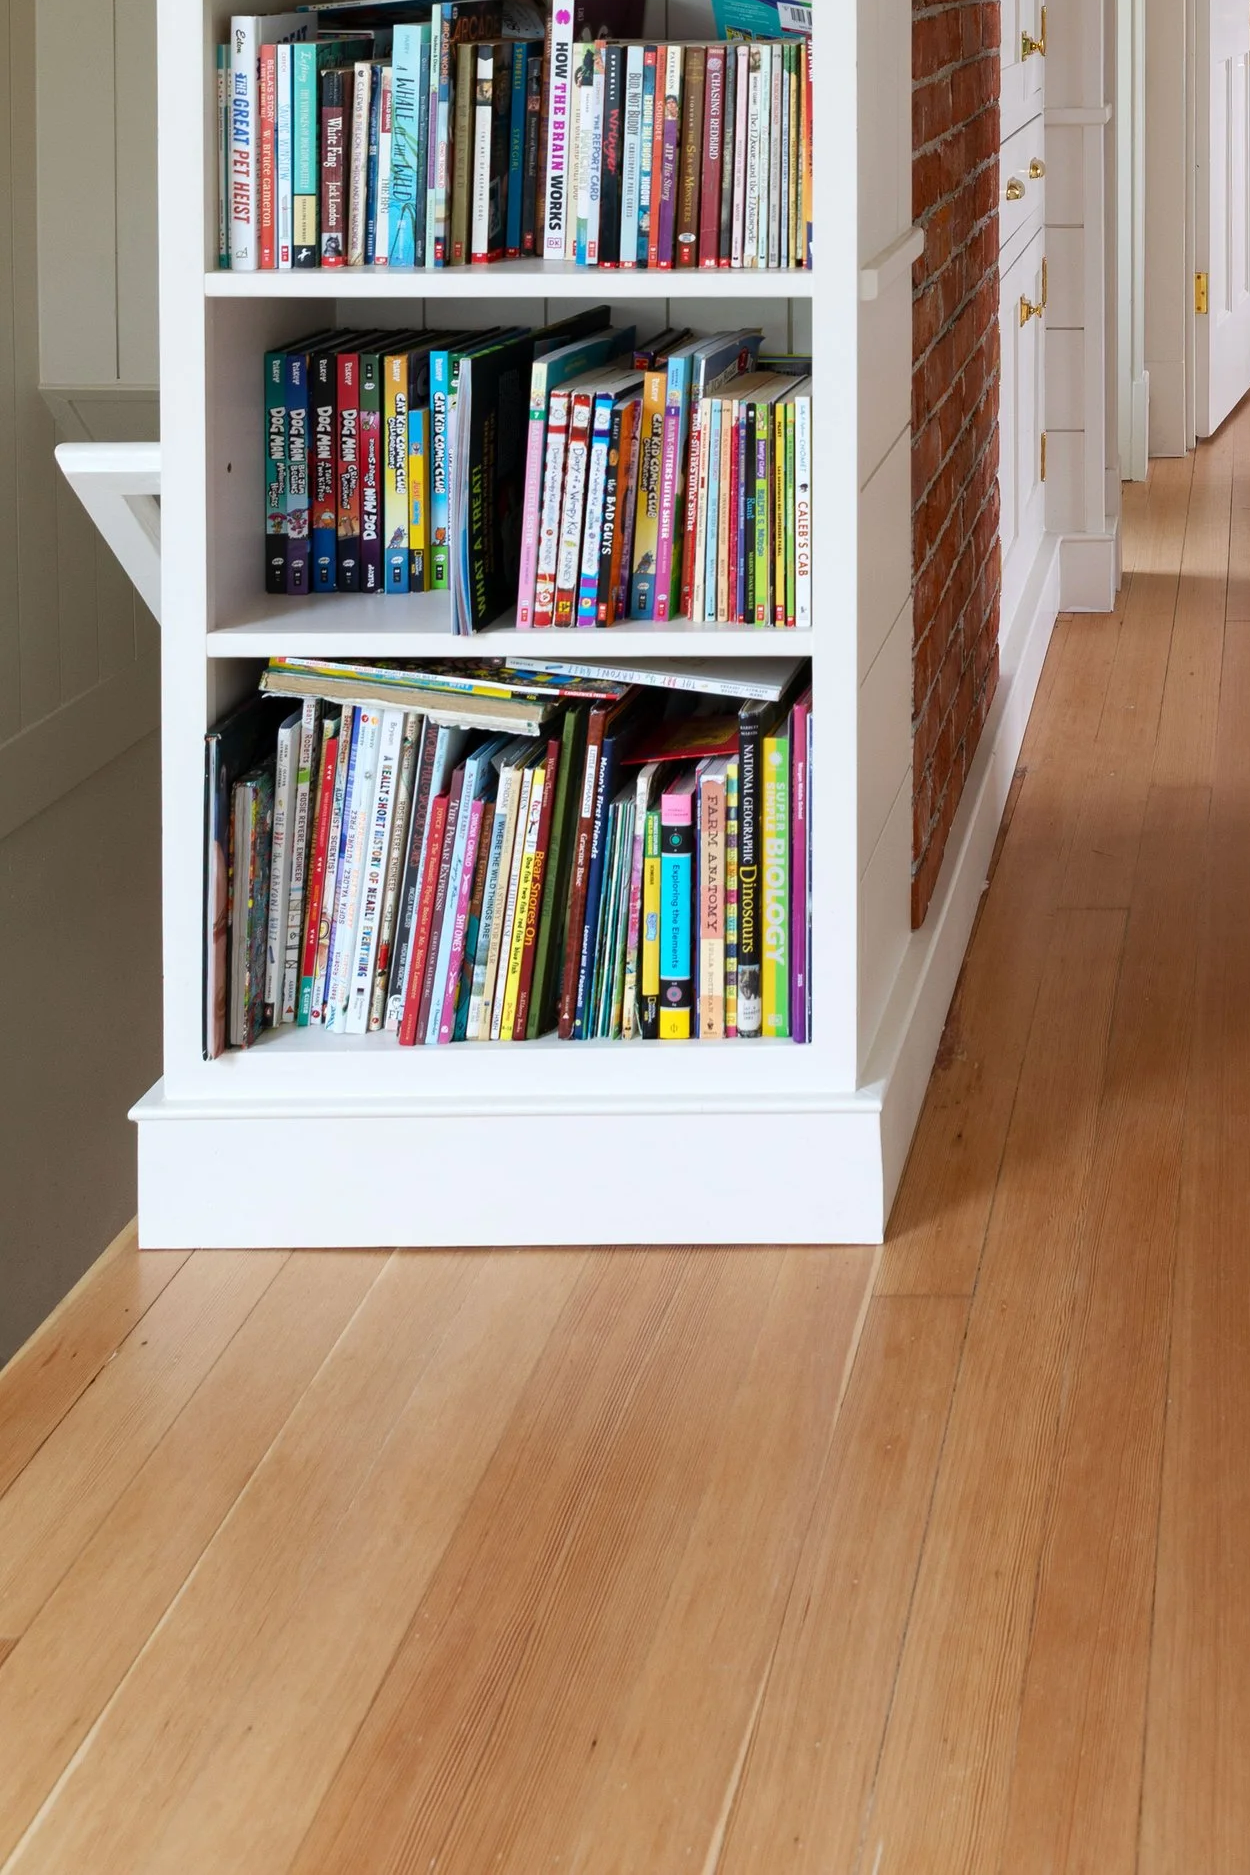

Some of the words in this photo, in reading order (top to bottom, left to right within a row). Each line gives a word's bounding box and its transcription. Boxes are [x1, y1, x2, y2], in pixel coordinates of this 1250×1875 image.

[440, 21, 450, 53] ARCADE
[439, 56, 449, 84] WORLD
[554, 41, 568, 78] HOW
[235, 76, 247, 95] THE
[266, 59, 274, 92] BELLA'S
[627, 72, 641, 90] BUD,
[553, 82, 566, 115] THE
[627, 92, 640, 108] NOT
[710, 72, 720, 115] CHASING
[233, 98, 249, 144] GREAT
[323, 115, 344, 145] White
[383, 110, 391, 129] DAHL
[625, 110, 639, 135] BUDDY
[551, 120, 564, 170] BRAIN
[708, 118, 719, 159] REDBIRD
[233, 149, 248, 176] PET
[323, 145, 342, 168] Fang
[234, 181, 249, 224] HEIST
[325, 181, 340, 196] Jack
[548, 174, 562, 230] WORKS
[327, 198, 339, 226] London
[270, 407, 285, 433] DOG
[289, 408, 304, 433] DOG
[316, 406, 332, 431] DOG
[342, 409, 356, 433] DOG
[270, 434, 284, 459] MAN
[289, 436, 304, 461] MAN
[316, 433, 332, 457] MAN
[342, 436, 356, 461] MAN
[362, 487, 376, 512] MAN
[470, 465, 483, 532] TREAT!
[607, 479, 615, 492] the
[604, 496, 615, 520] BAD
[744, 497, 755, 519] Runt
[362, 515, 376, 539] DOG
[798, 501, 808, 547] CALEB'S
[473, 537, 481, 549] A
[543, 538, 552, 565] KINNEY
[601, 524, 613, 554] GUYS
[563, 551, 572, 582] KINNEY
[798, 553, 808, 575] CAB
[472, 560, 488, 616] WHAT
[743, 744, 754, 795] NATIONAL
[501, 777, 512, 808] SENDAK
[766, 782, 774, 831] SIMPLE
[776, 782, 784, 831] SUPER
[447, 799, 459, 823] THE
[707, 795, 717, 846] FARM
[441, 825, 455, 859] POLAR
[494, 820, 505, 850] WHERE
[742, 797, 753, 863] GEOGRAPHIC
[491, 851, 501, 868] THE
[577, 832, 588, 865] Graeme
[531, 850, 544, 880] Bear
[574, 867, 584, 887] Base
[434, 863, 450, 911] EXPRESS
[488, 871, 498, 889] WILD
[707, 852, 717, 931] ANATOMY
[484, 890, 495, 920] THINGS
[525, 882, 540, 926] Snores
[739, 865, 756, 952] Dinosaurs
[765, 837, 784, 965] BIOLOGY
[454, 913, 465, 928] SHY
[482, 923, 491, 939] ARE
[451, 928, 463, 952] ONES
[523, 927, 535, 946] On
